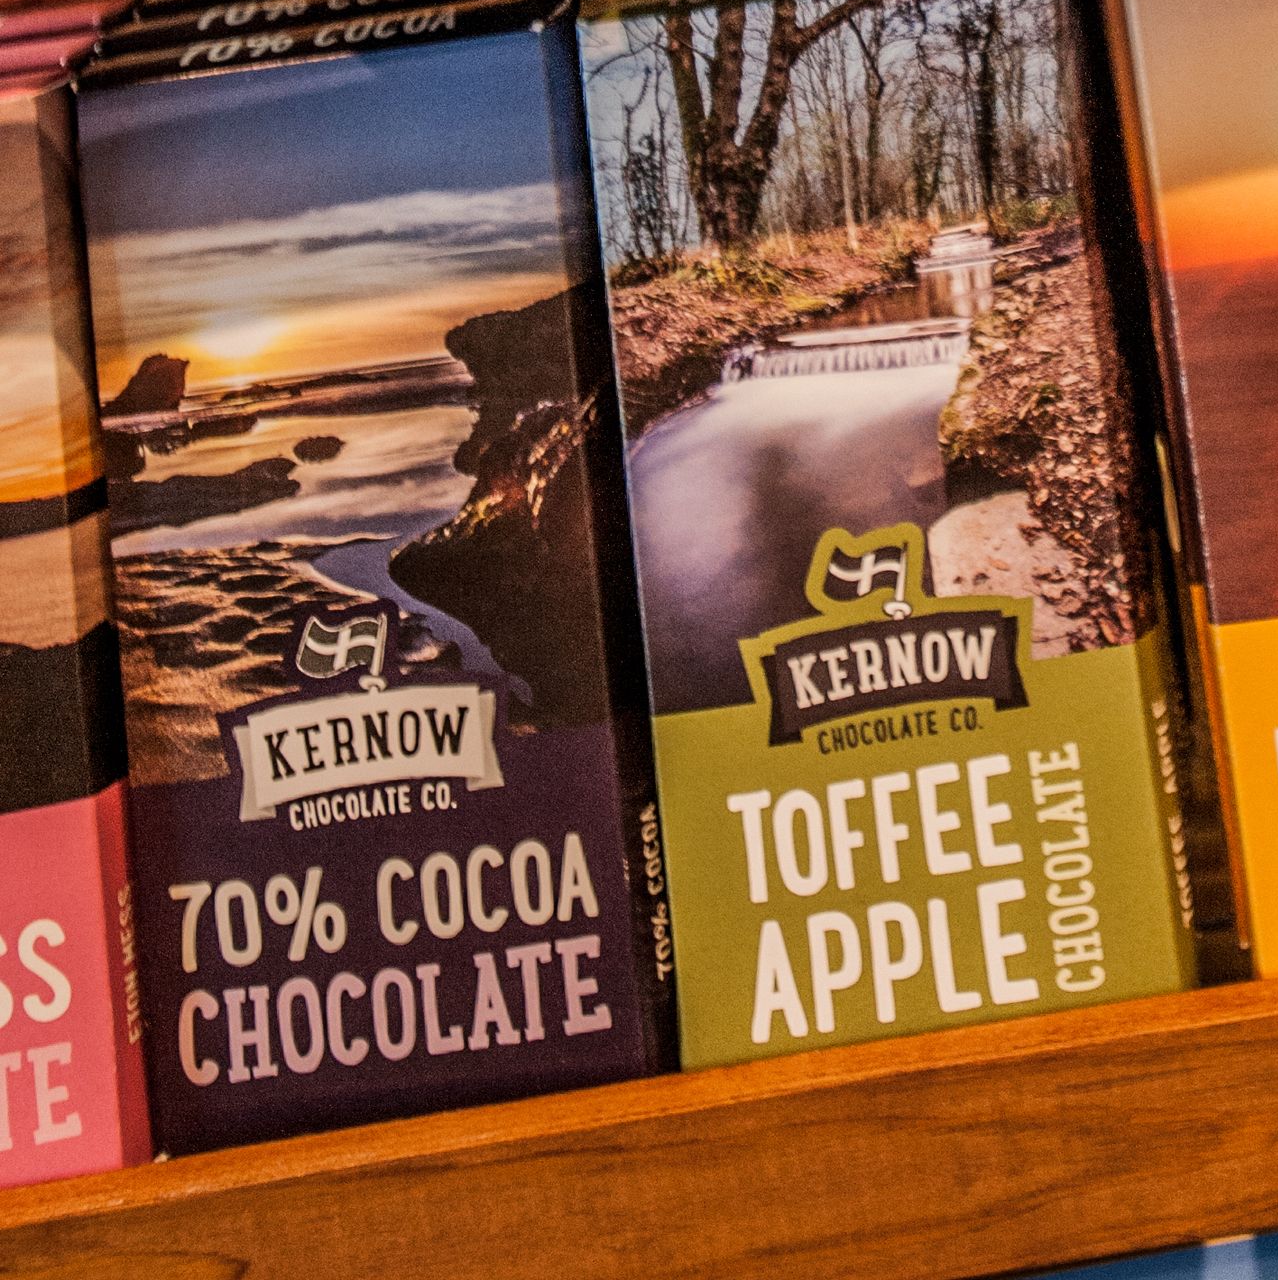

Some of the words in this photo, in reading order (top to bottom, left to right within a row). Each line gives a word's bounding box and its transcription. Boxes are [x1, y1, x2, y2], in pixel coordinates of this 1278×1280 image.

[787, 627, 997, 710] KERNOW
[264, 705, 469, 780] KERNOW
[817, 710, 940, 755] CHOCOLATE
[949, 706, 985, 733] CO.
[289, 785, 412, 831] CHOCOLATE
[421, 782, 457, 812] CO.
[640, 802, 664, 895] COCOA
[726, 754, 1024, 905] TOFFEE
[168, 867, 347, 973] 70%
[376, 832, 599, 946] COCOA
[1029, 741, 1107, 994] CHOCOLATE
[178, 935, 612, 1087] CHOCOLATE
[750, 878, 1040, 1045] APPLE
